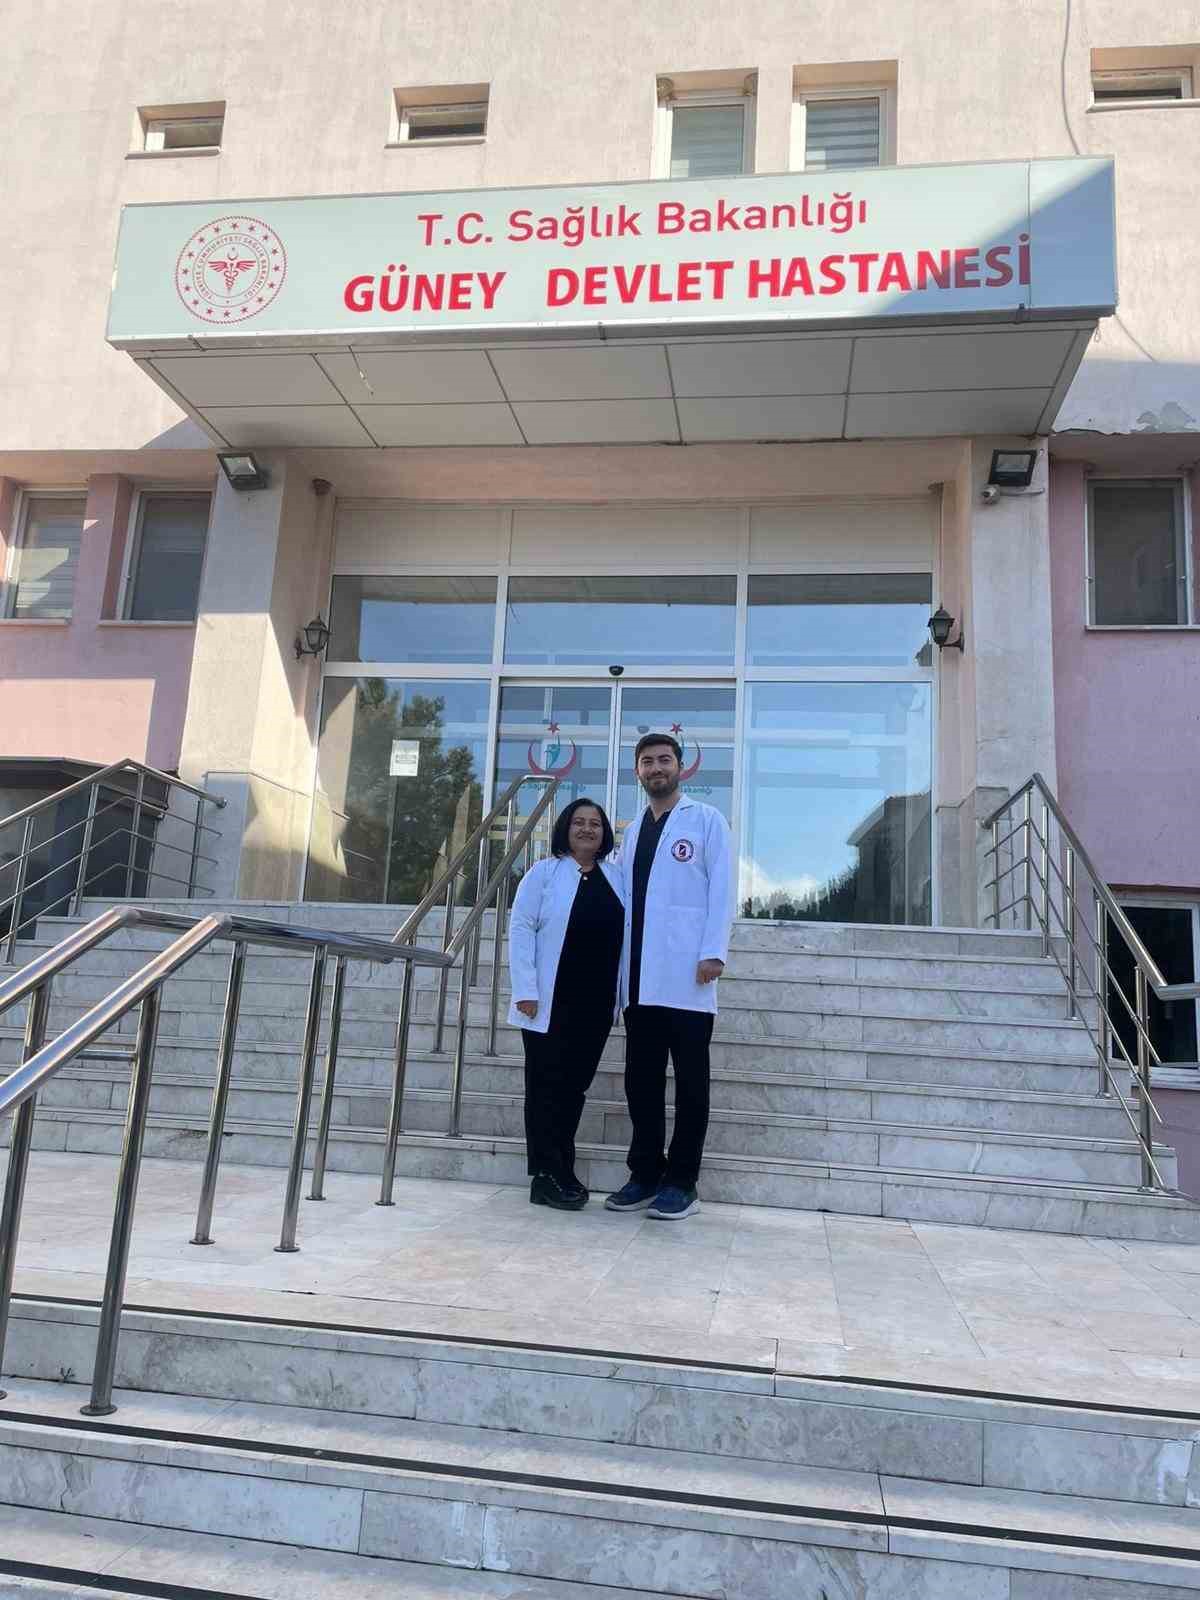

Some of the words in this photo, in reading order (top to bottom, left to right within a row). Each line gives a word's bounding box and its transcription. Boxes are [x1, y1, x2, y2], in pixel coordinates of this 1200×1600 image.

[417, 212, 493, 246] T.C.
[507, 204, 642, 247] Sağlık
[657, 192, 867, 234] Bakanlığı
[343, 263, 506, 313] GÜNEY
[546, 260, 735, 306] DEVLET
[747, 233, 1031, 299] HASTANESİ
